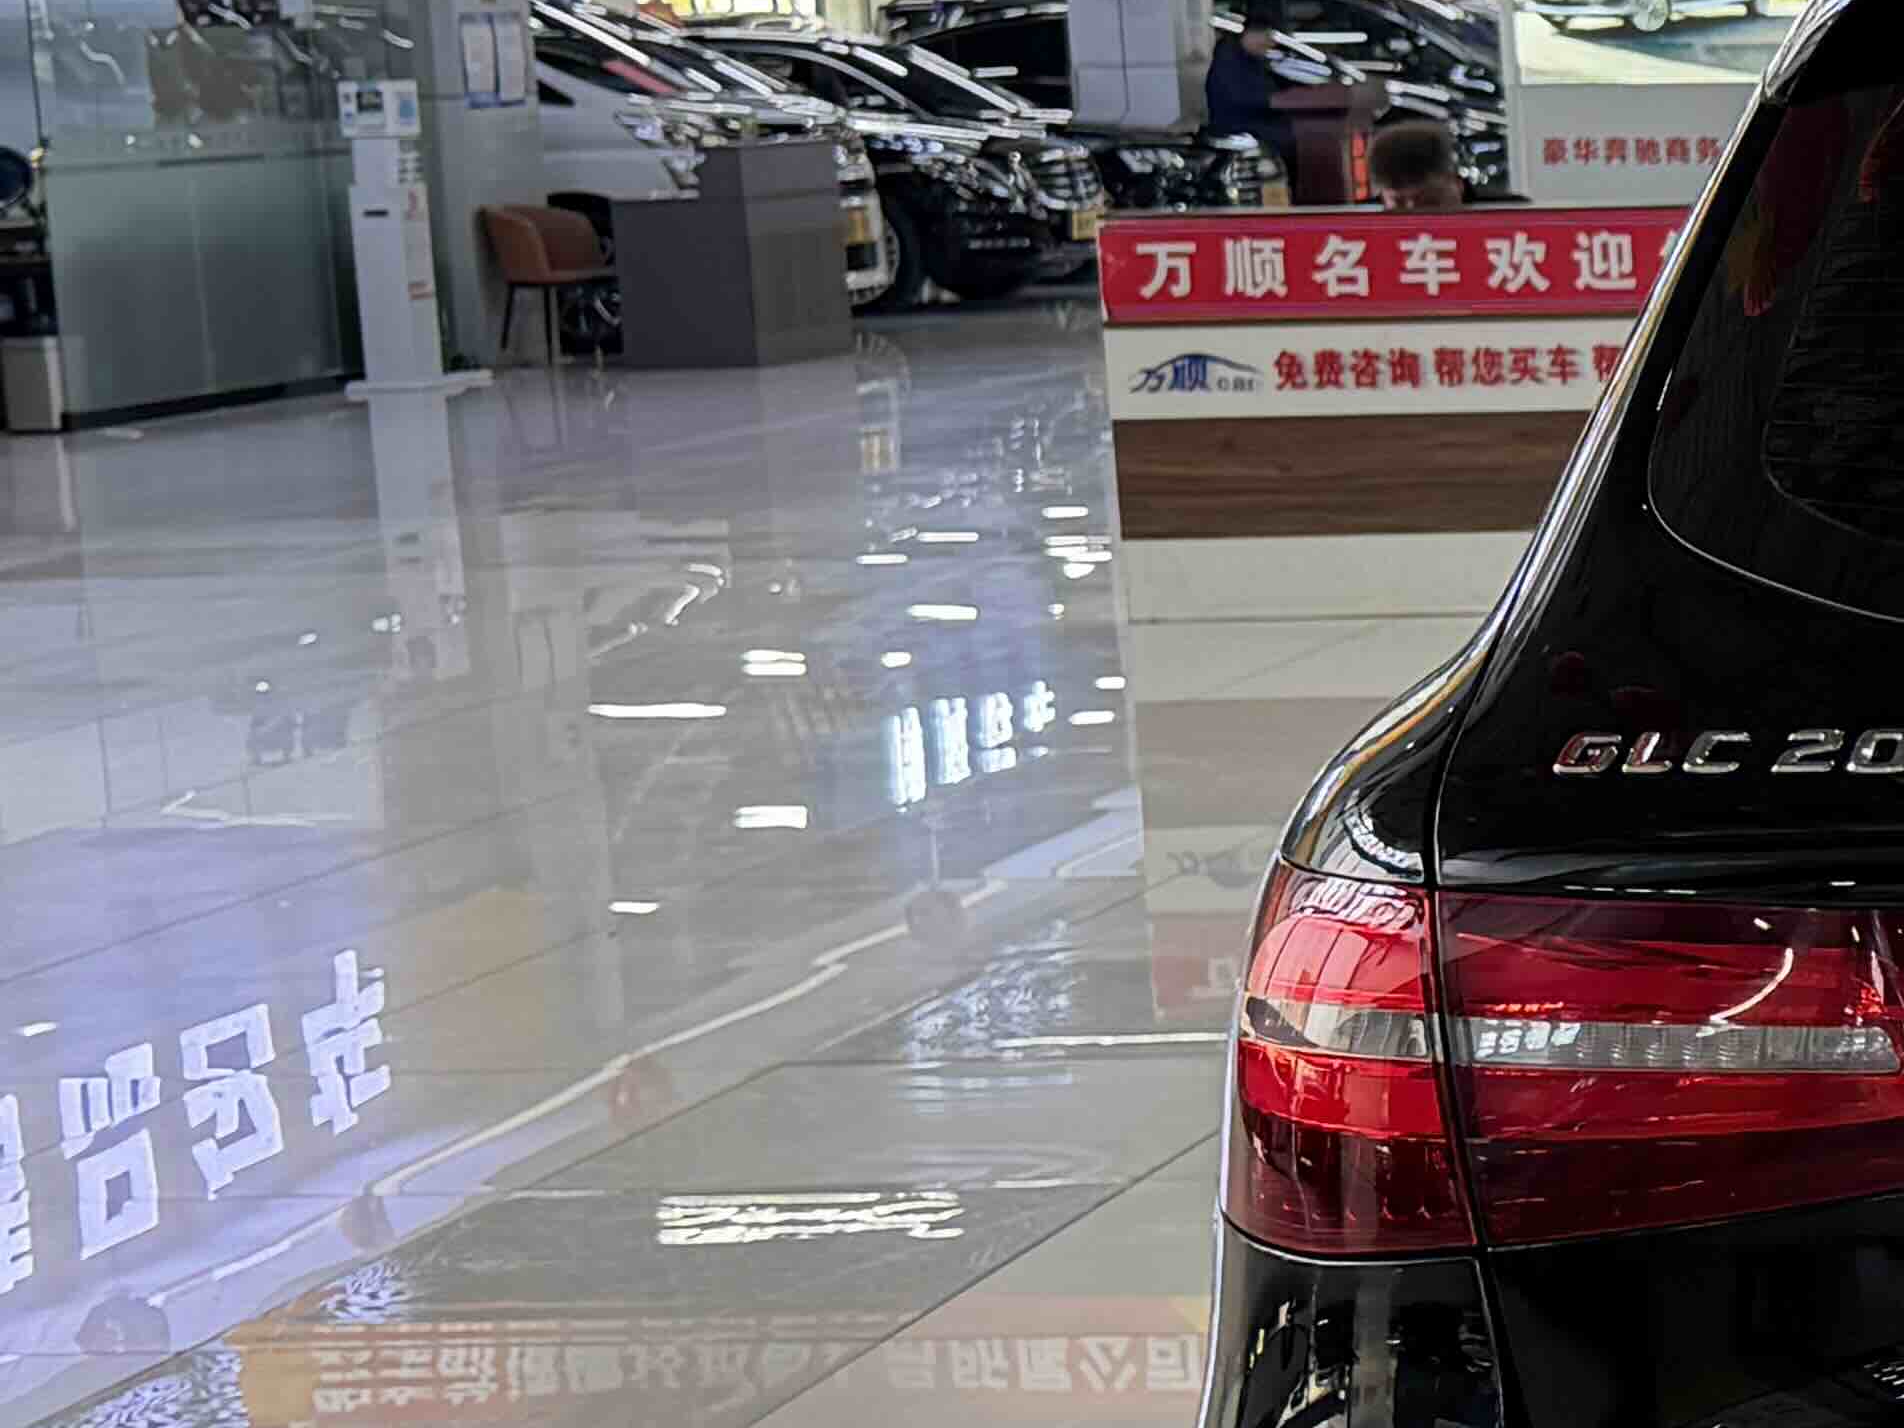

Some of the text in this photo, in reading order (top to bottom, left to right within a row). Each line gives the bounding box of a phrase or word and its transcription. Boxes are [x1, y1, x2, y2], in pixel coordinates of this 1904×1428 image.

[1136, 229, 1674, 301] 万顺名车欢迎
[1273, 349, 1421, 391] 免费咨询
[1434, 344, 1581, 389] 帮您买车
[1553, 730, 1751, 773] GLC
